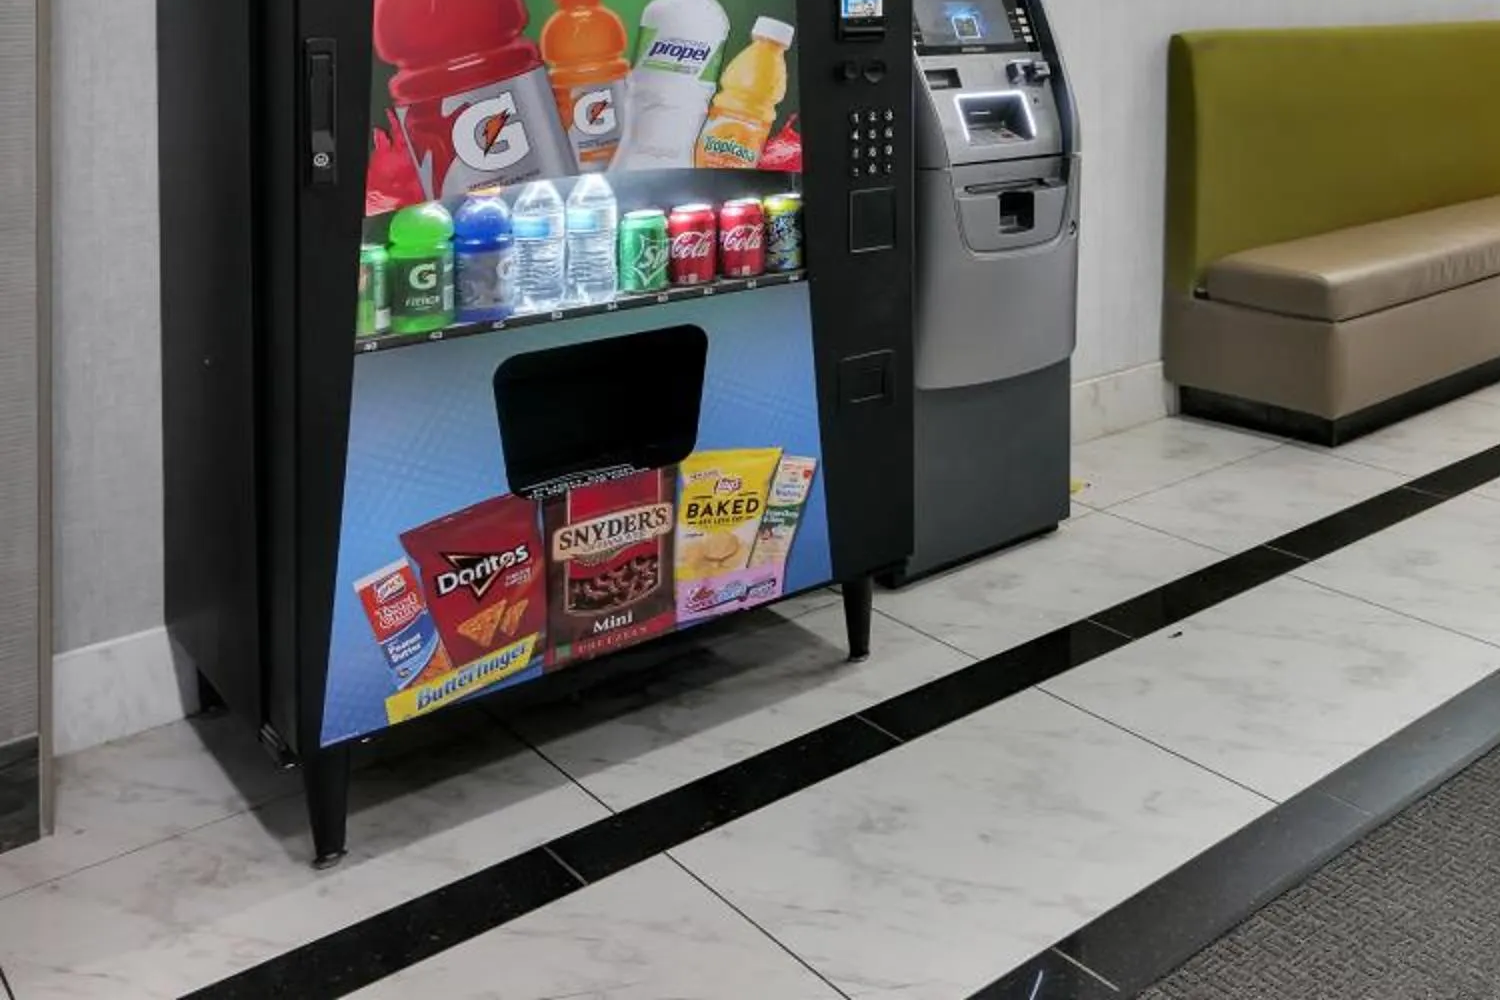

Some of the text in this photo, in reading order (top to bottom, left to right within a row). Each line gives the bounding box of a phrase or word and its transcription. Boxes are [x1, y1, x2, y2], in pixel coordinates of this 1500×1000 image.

[649, 41, 711, 62] propel
[573, 89, 616, 135] G
[452, 91, 530, 172] G
[704, 135, 756, 161] Tropicana
[409, 263, 437, 290] G
[687, 498, 759, 519] BAKED
[559, 507, 668, 551] SNYDER'S
[436, 544, 530, 596] Doritos
[592, 610, 633, 633] Mini
[388, 632, 422, 654] Peanut
[391, 644, 422, 663] Butter
[416, 642, 527, 710] Butterfinger
